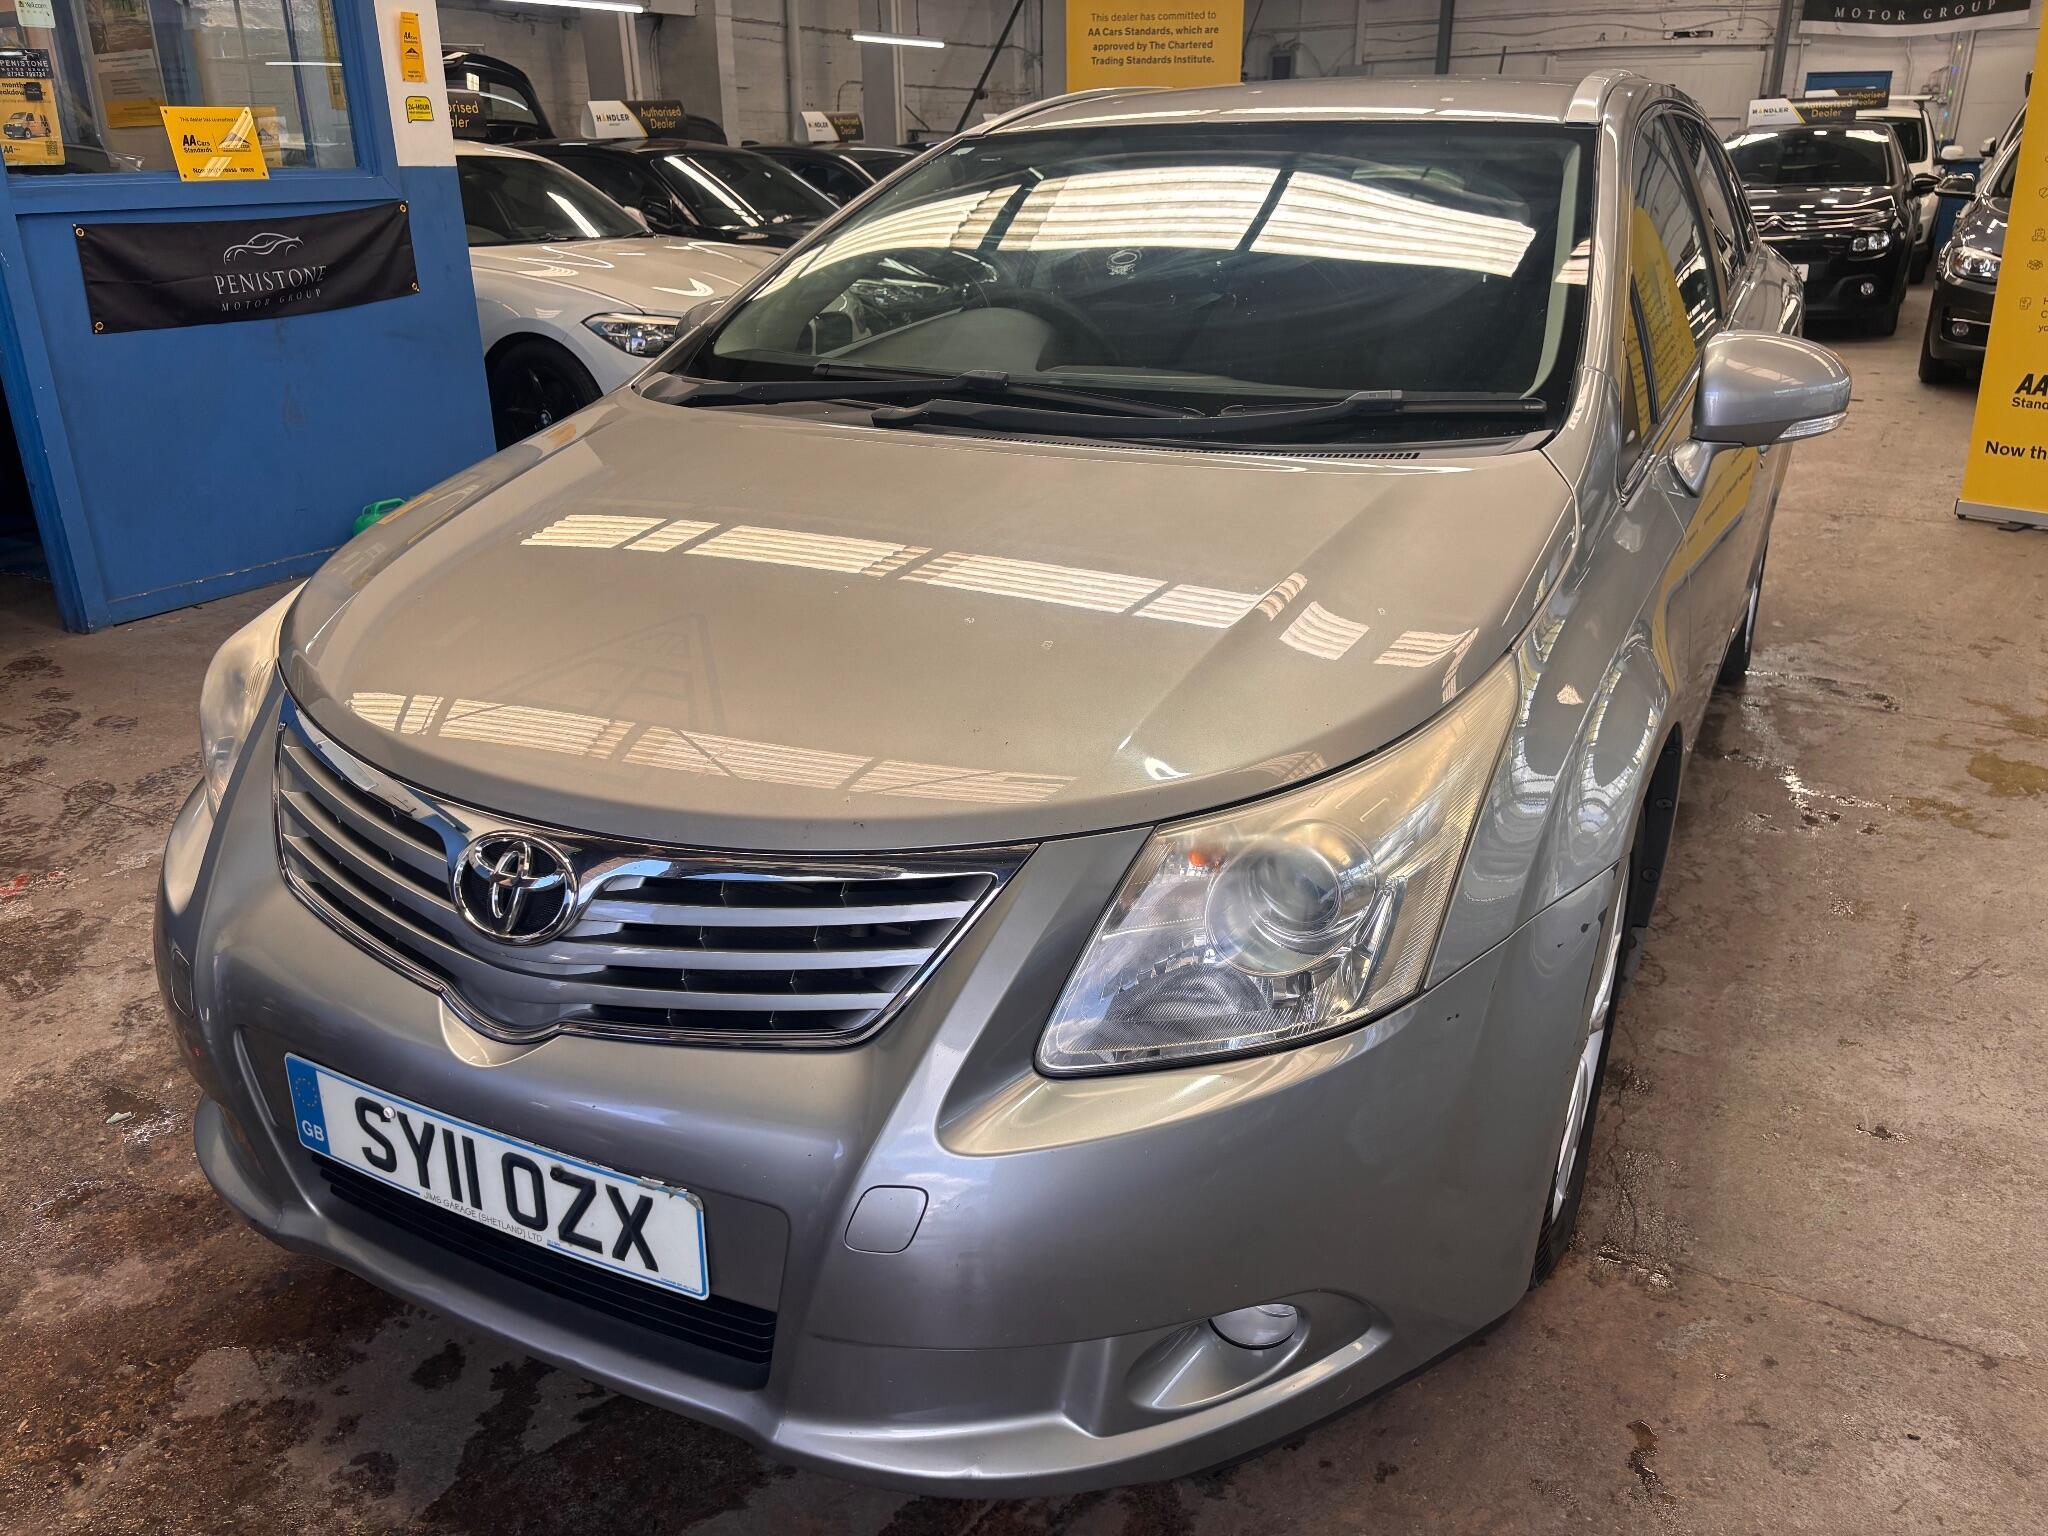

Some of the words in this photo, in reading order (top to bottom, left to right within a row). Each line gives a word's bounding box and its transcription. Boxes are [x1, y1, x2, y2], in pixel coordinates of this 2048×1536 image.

[1091, 13, 1108, 22] This
[1111, 12, 1138, 22] dealer
[1140, 12, 1155, 21] has
[1158, 11, 1206, 21] committed
[1207, 11, 1217, 20] to
[1835, 7, 1906, 21] MOTOR
[1923, 0, 1996, 20] GROUP
[1088, 28, 1101, 37] AA
[1102, 28, 1123, 37] Cars
[1125, 27, 1174, 37] Standards,
[1175, 25, 1202, 35] which
[1204, 26, 1219, 35] are
[1093, 42, 1135, 52] approved
[1136, 42, 1147, 52] by
[1149, 41, 1165, 50] The
[1168, 40, 1213, 50] Chartered
[1091, 57, 1124, 66] Trading
[1126, 56, 1172, 65] Standards
[1173, 55, 1215, 65] Institute.
[641, 106, 682, 117] Authorised
[1811, 109, 1841, 118] Dealer
[650, 118, 676, 129] Dealer
[183, 134, 197, 146] AA
[214, 265, 327, 295] PENISTONE
[222, 298, 270, 312] MOTOR
[280, 288, 321, 304] GROUP
[1984, 440, 2025, 458] Now
[302, 1120, 325, 1141] GB
[355, 1097, 483, 1211] SY11
[444, 1199, 477, 1218] GARAGE
[528, 1230, 543, 1243] LTD
